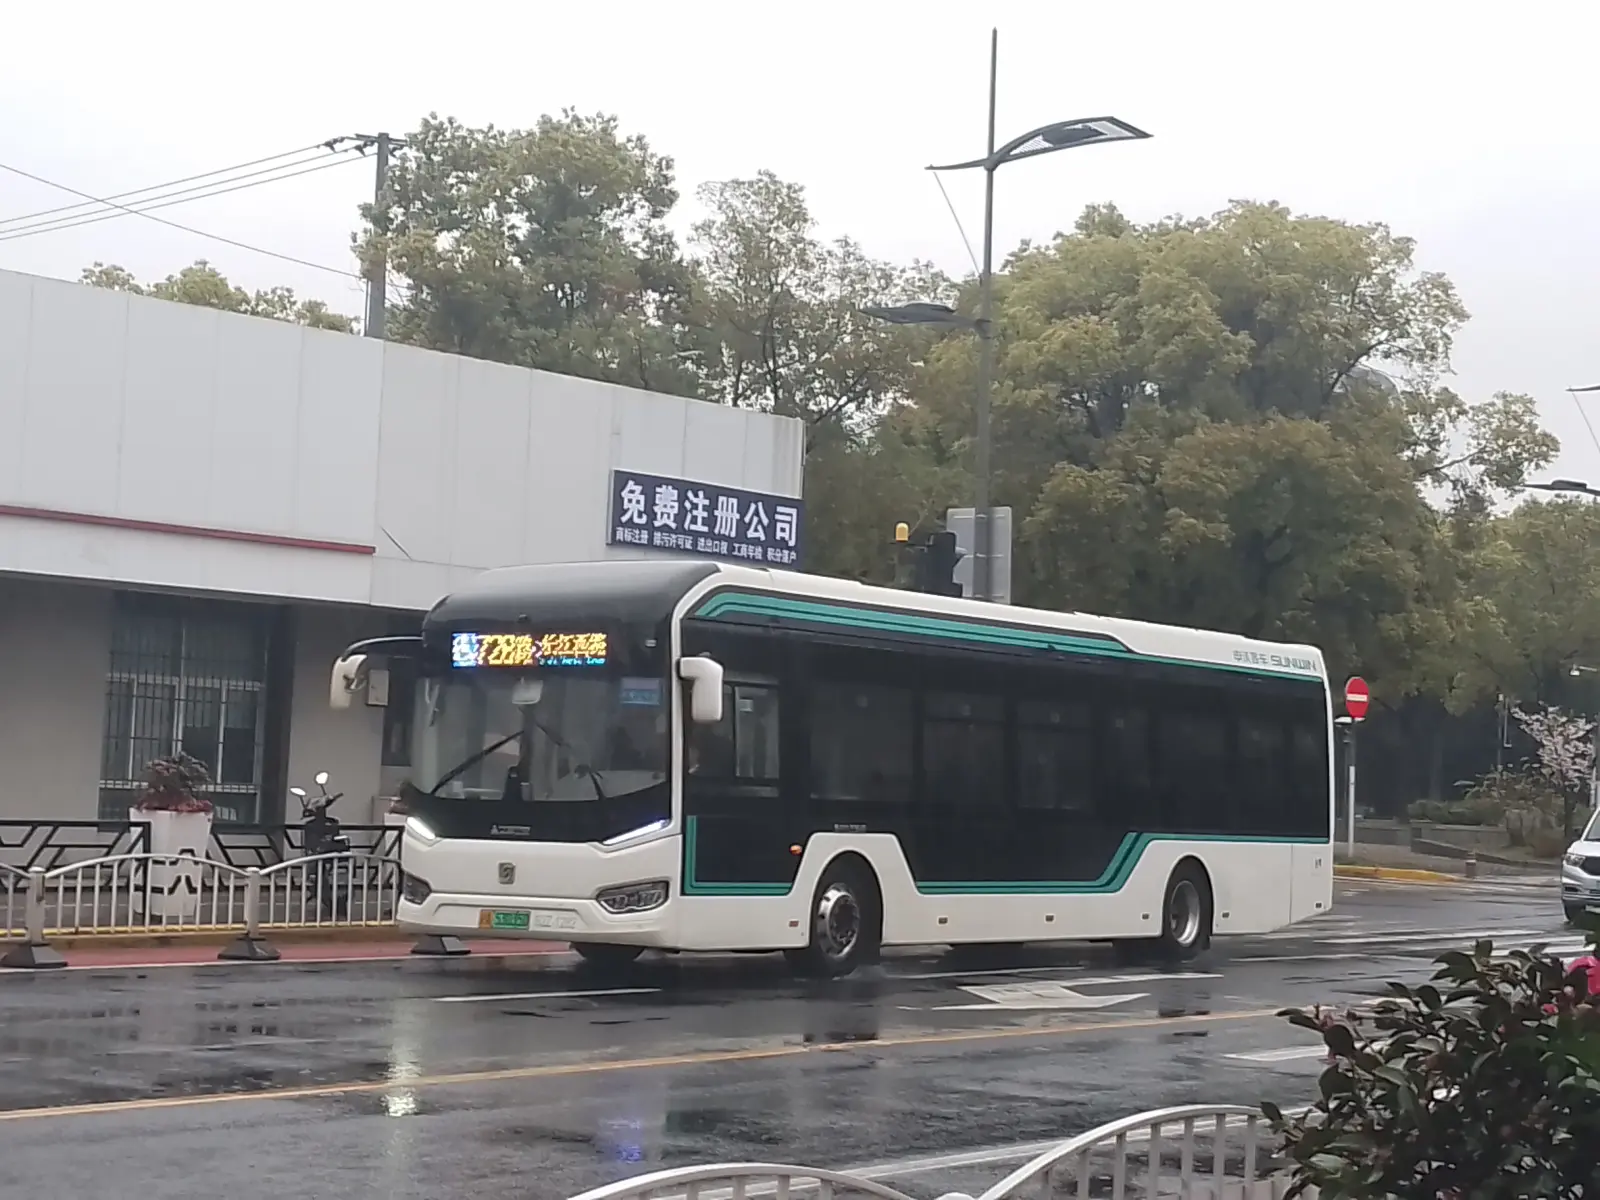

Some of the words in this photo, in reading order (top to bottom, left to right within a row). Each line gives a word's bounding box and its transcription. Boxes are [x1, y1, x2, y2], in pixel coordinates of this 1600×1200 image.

[619, 479, 798, 547] 免费注册公司
[615, 526, 649, 544] 商标注册
[1270, 654, 1317, 671] SUNWIN
